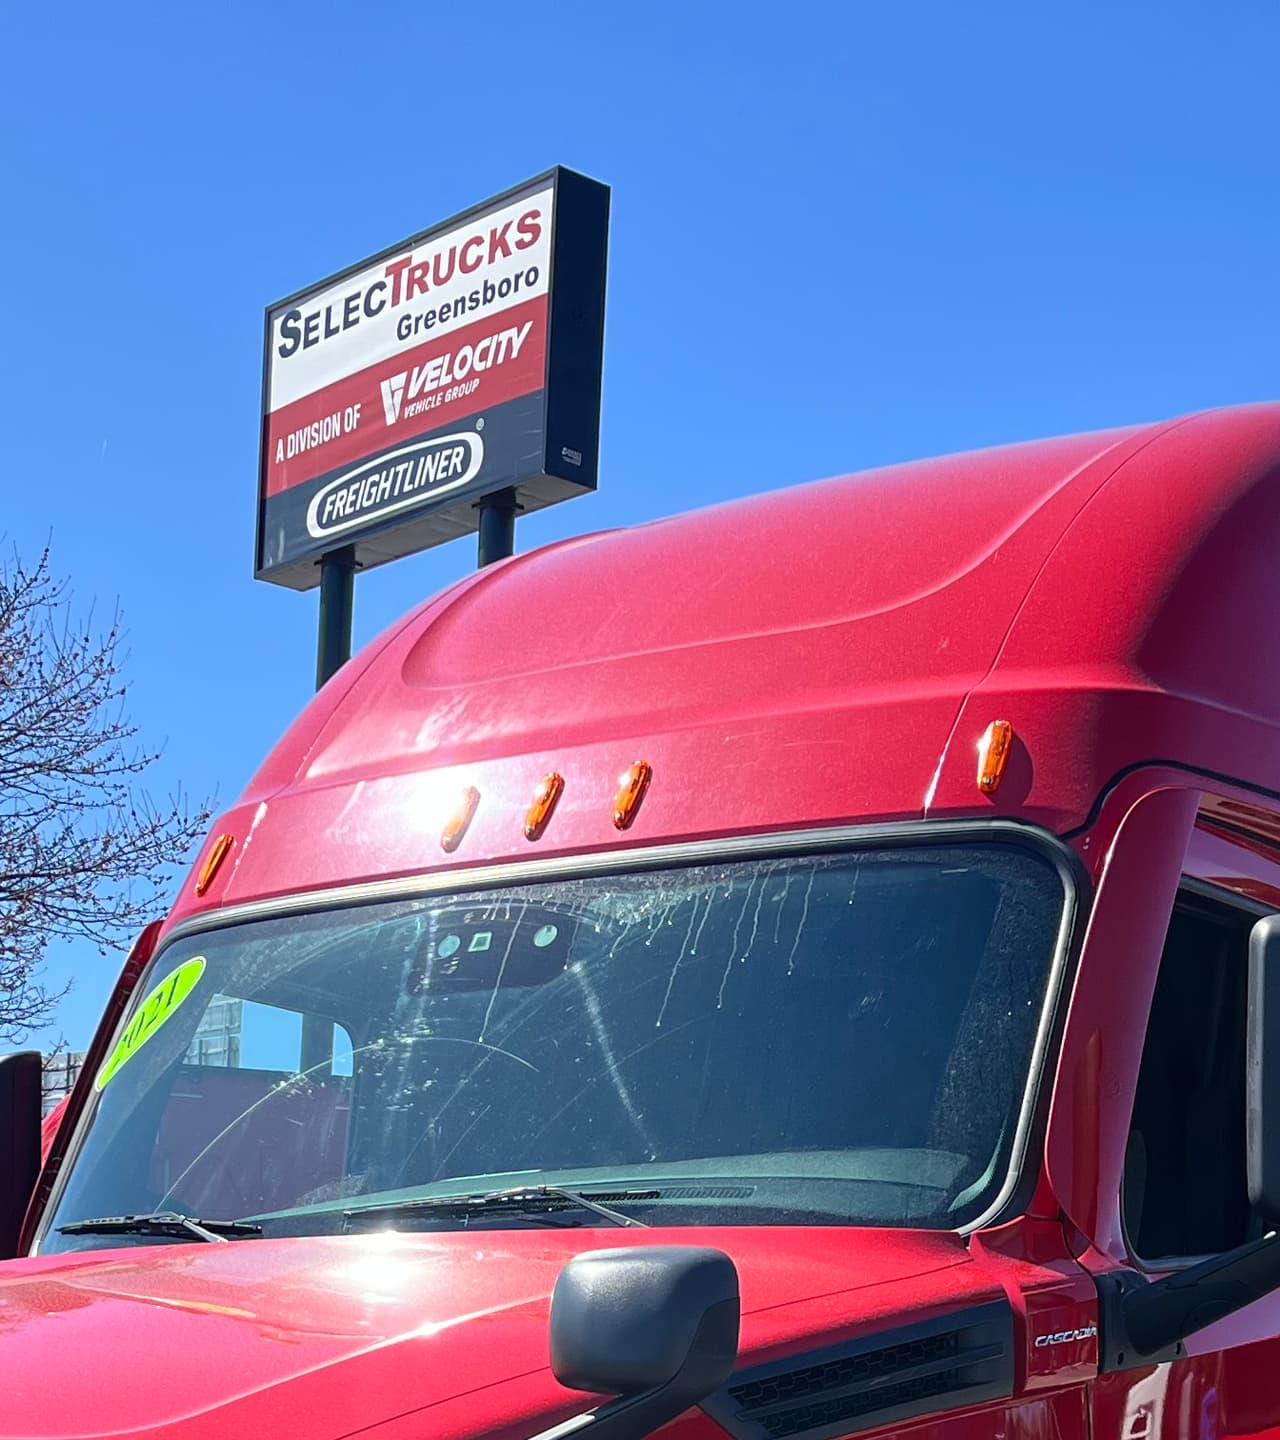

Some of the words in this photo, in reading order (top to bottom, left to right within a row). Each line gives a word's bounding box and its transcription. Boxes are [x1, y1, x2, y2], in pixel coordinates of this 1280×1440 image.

[278, 208, 542, 358] SELECTRUCKS
[396, 265, 539, 341] Greensboro
[407, 320, 534, 400] VELOCITY
[275, 438, 285, 464] A
[287, 412, 341, 460] DIVISION
[344, 403, 362, 432] OF
[404, 391, 443, 419] VEHICLE
[445, 378, 480, 403] GROUP
[322, 446, 466, 524] FREIGHTLINER
[1034, 1326, 1098, 1348] CASCADIA
